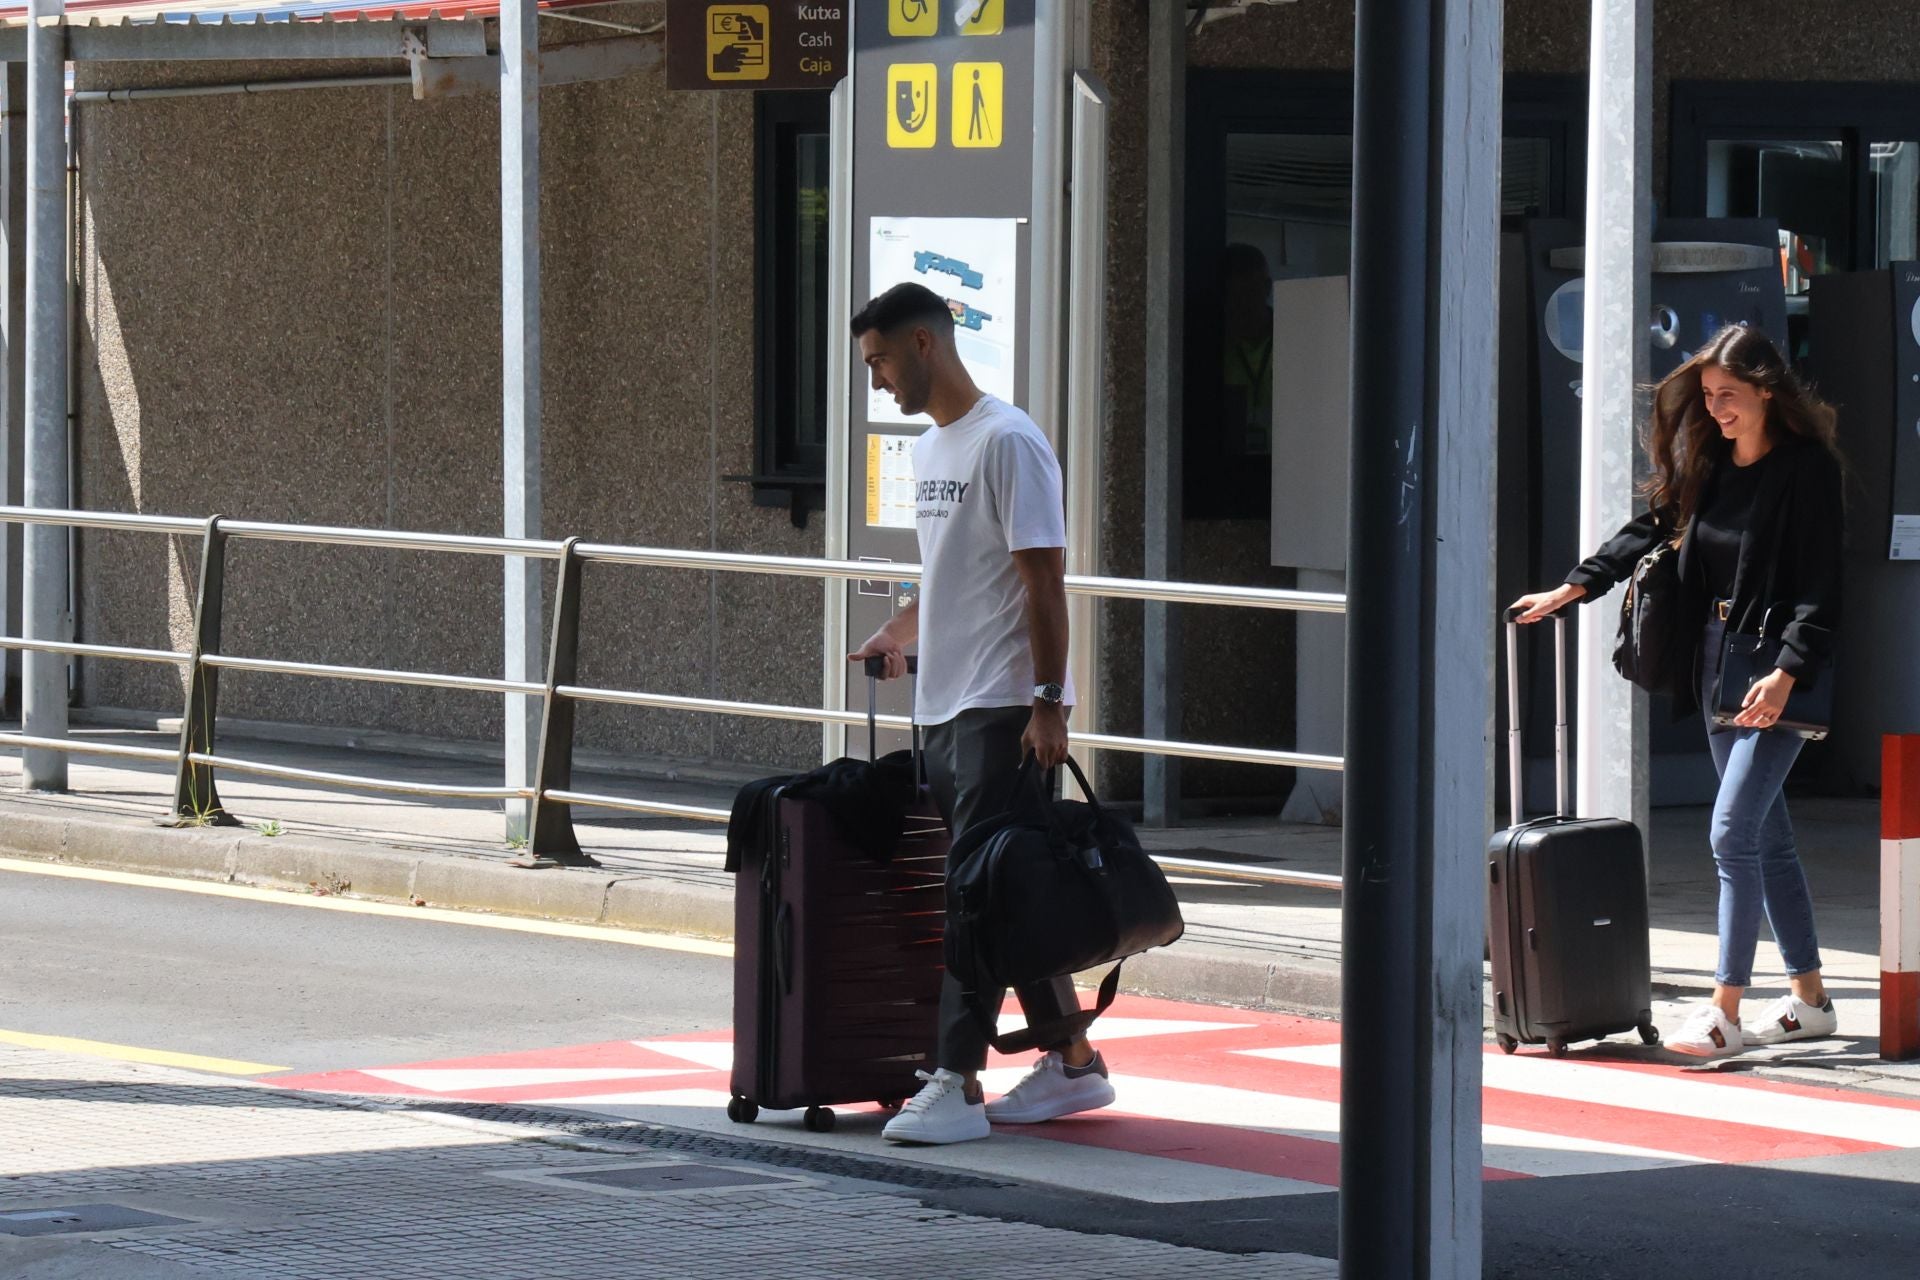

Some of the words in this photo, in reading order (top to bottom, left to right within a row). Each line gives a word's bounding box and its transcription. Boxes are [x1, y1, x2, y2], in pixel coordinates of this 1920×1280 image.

[798, 5, 841, 20] Kutxa
[798, 31, 833, 47] Cash
[799, 56, 832, 76] Caja
[916, 480, 969, 503] URBERRY
